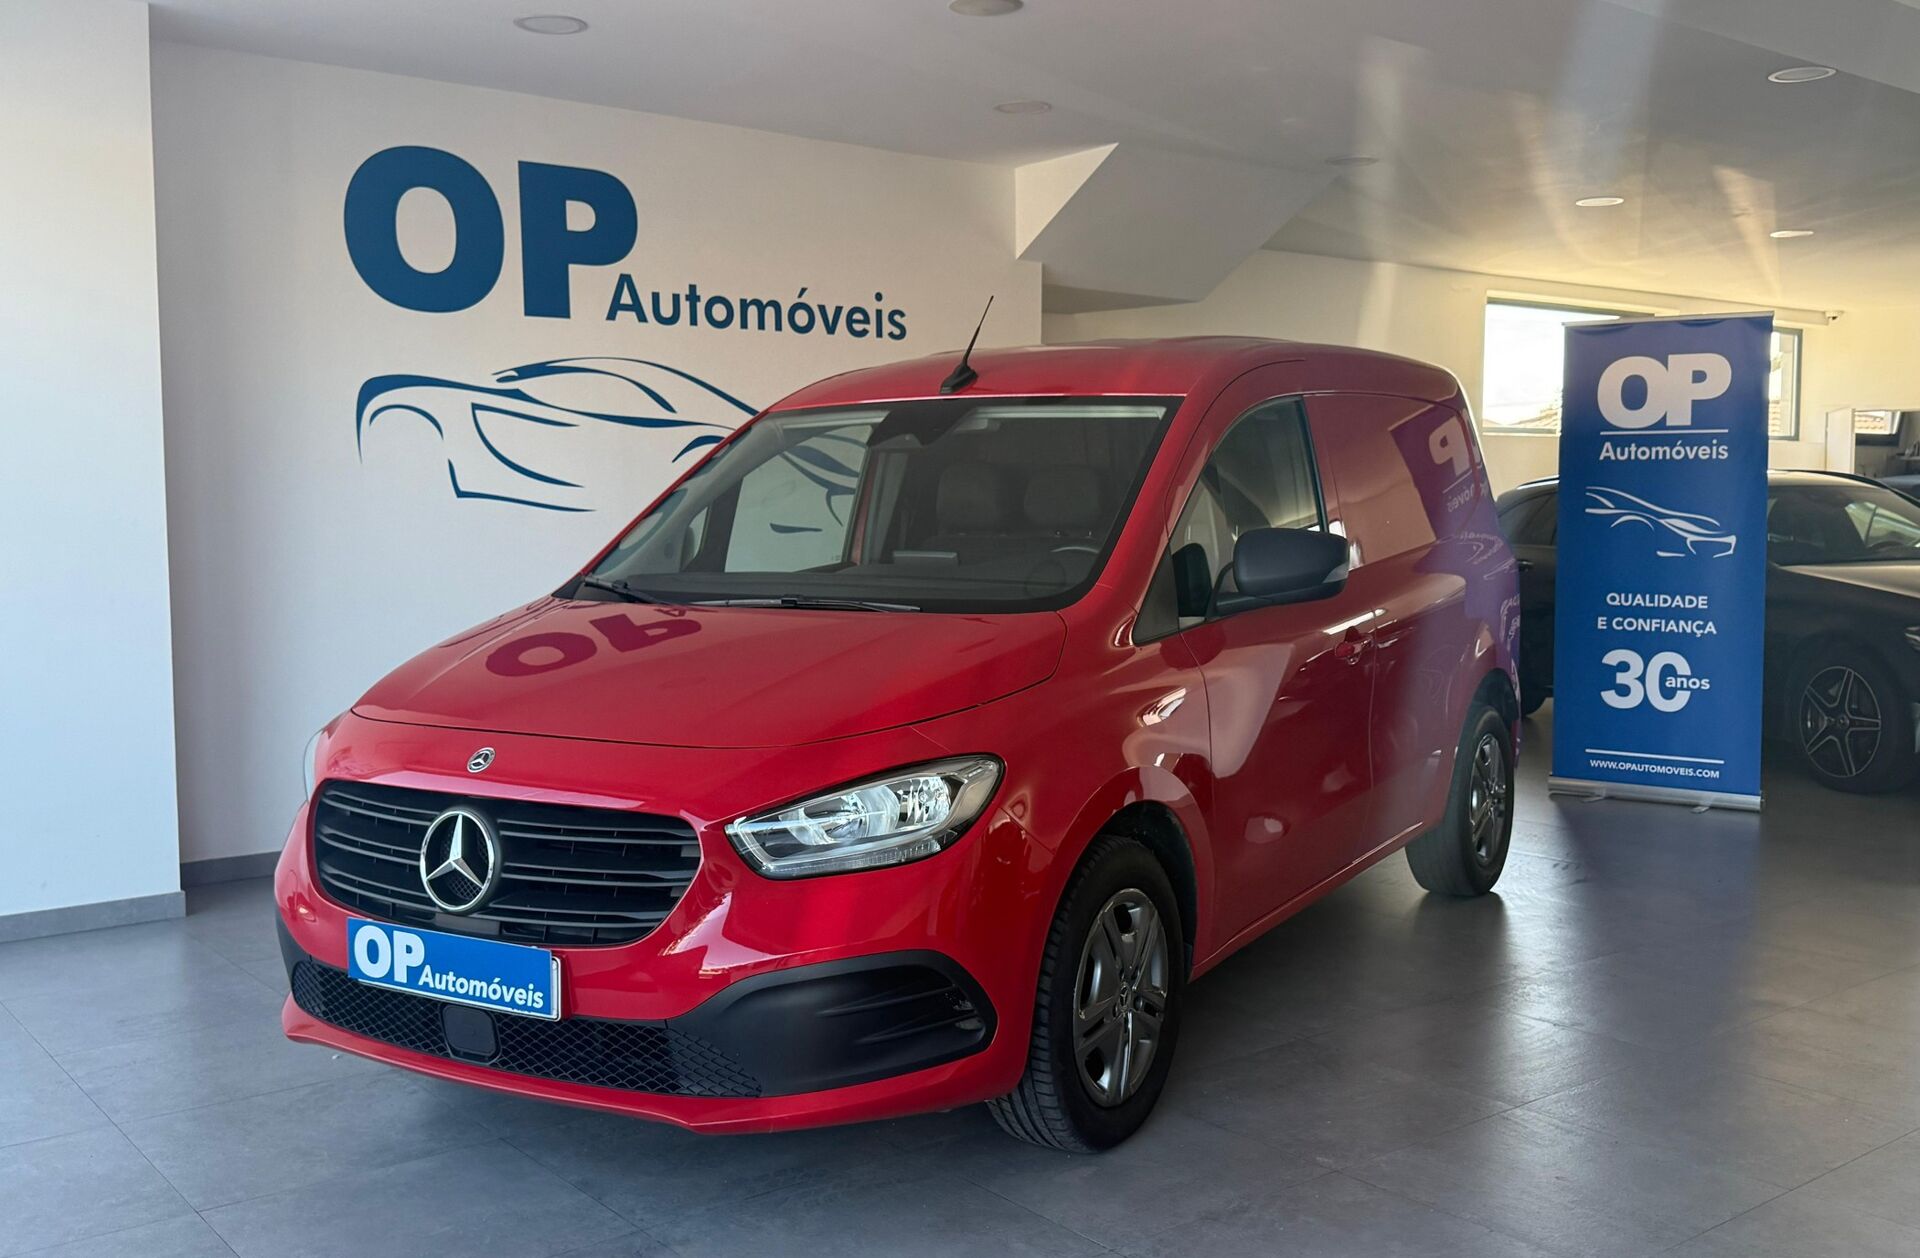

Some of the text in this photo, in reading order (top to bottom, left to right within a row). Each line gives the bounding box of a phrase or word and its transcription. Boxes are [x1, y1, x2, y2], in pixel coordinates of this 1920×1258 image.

[344, 145, 907, 341] OP Automóveis
[1597, 353, 1732, 429] OP
[1599, 439, 1729, 461] Automóveis
[1606, 592, 1708, 609] QUALIDADE
[1597, 616, 1717, 637] E CONFIANÇA
[1600, 649, 1710, 712] 30 anos
[1590, 759, 1720, 779] WWW.OPAUTOMOVEIS.COM
[354, 925, 544, 1009] OP Automóveis
